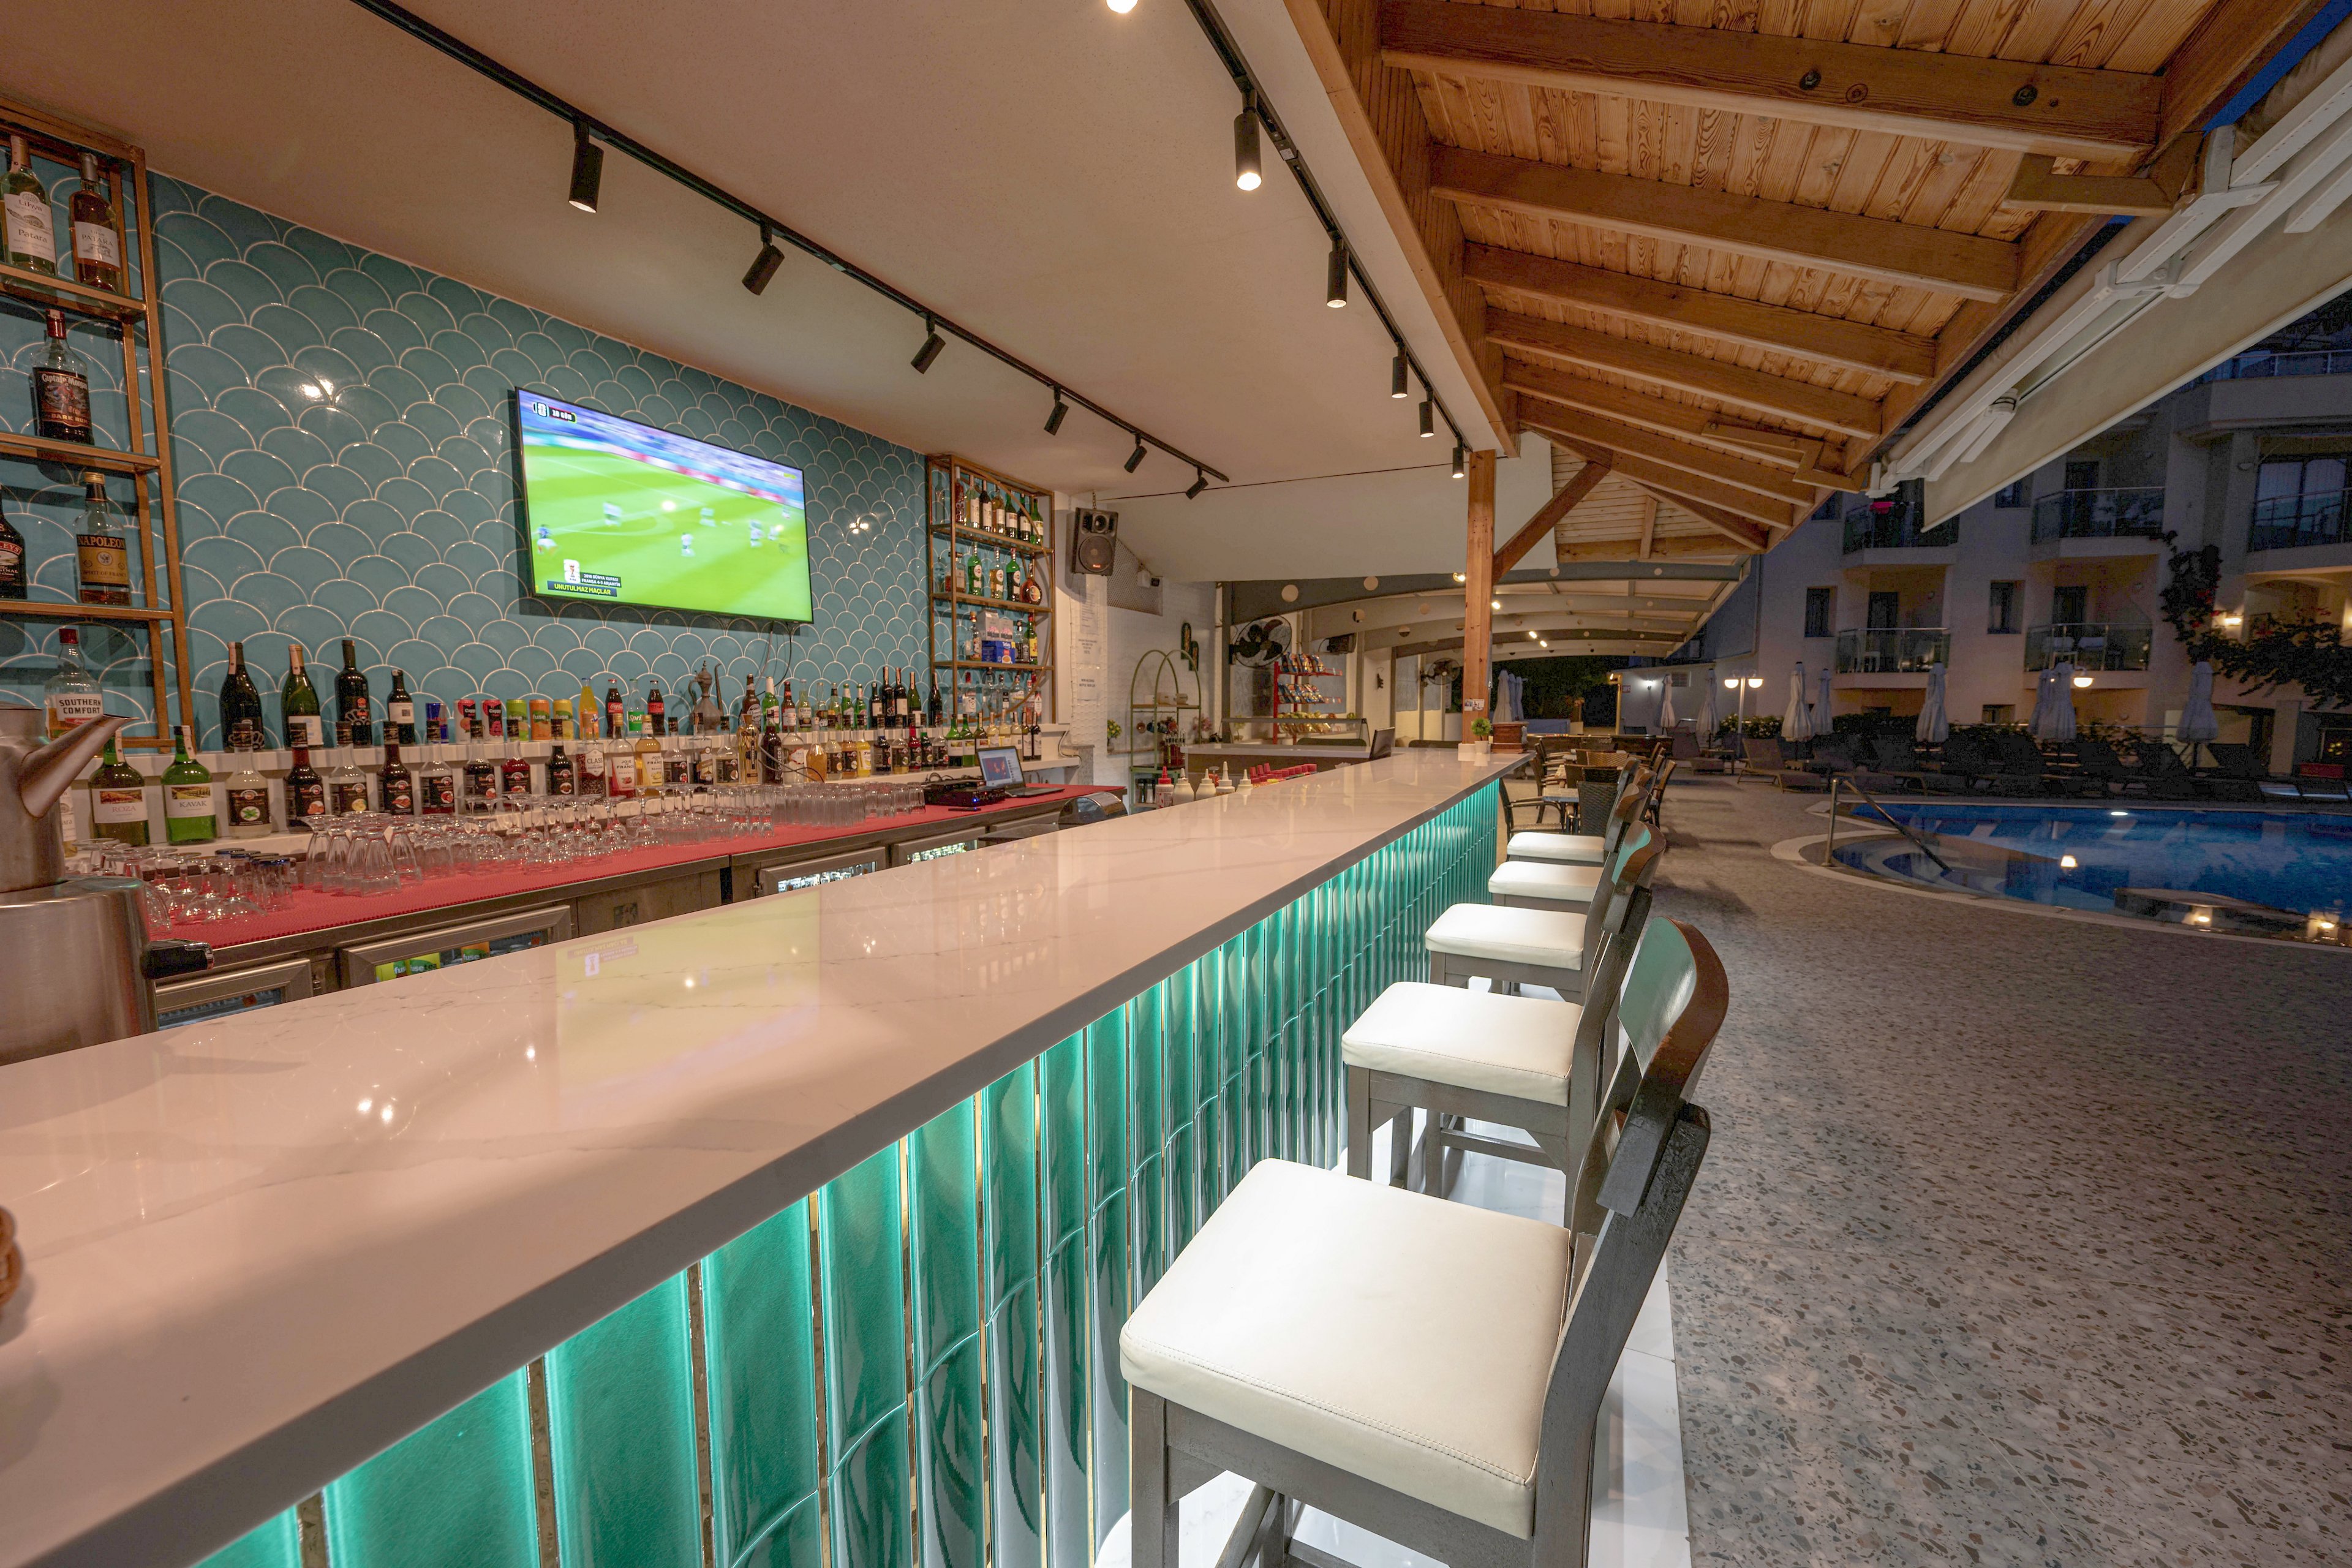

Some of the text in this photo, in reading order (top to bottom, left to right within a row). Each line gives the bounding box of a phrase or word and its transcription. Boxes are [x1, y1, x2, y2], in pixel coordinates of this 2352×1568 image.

[18, 228, 48, 243] Patara
[81, 234, 113, 247] PATARA
[42, 373, 67, 384] Captain
[77, 535, 126, 549] NAPOLEON
[554, 583, 611, 595] UNUTULMAZ MAÇLAR
[59, 698, 102, 707] SOUTHERN
